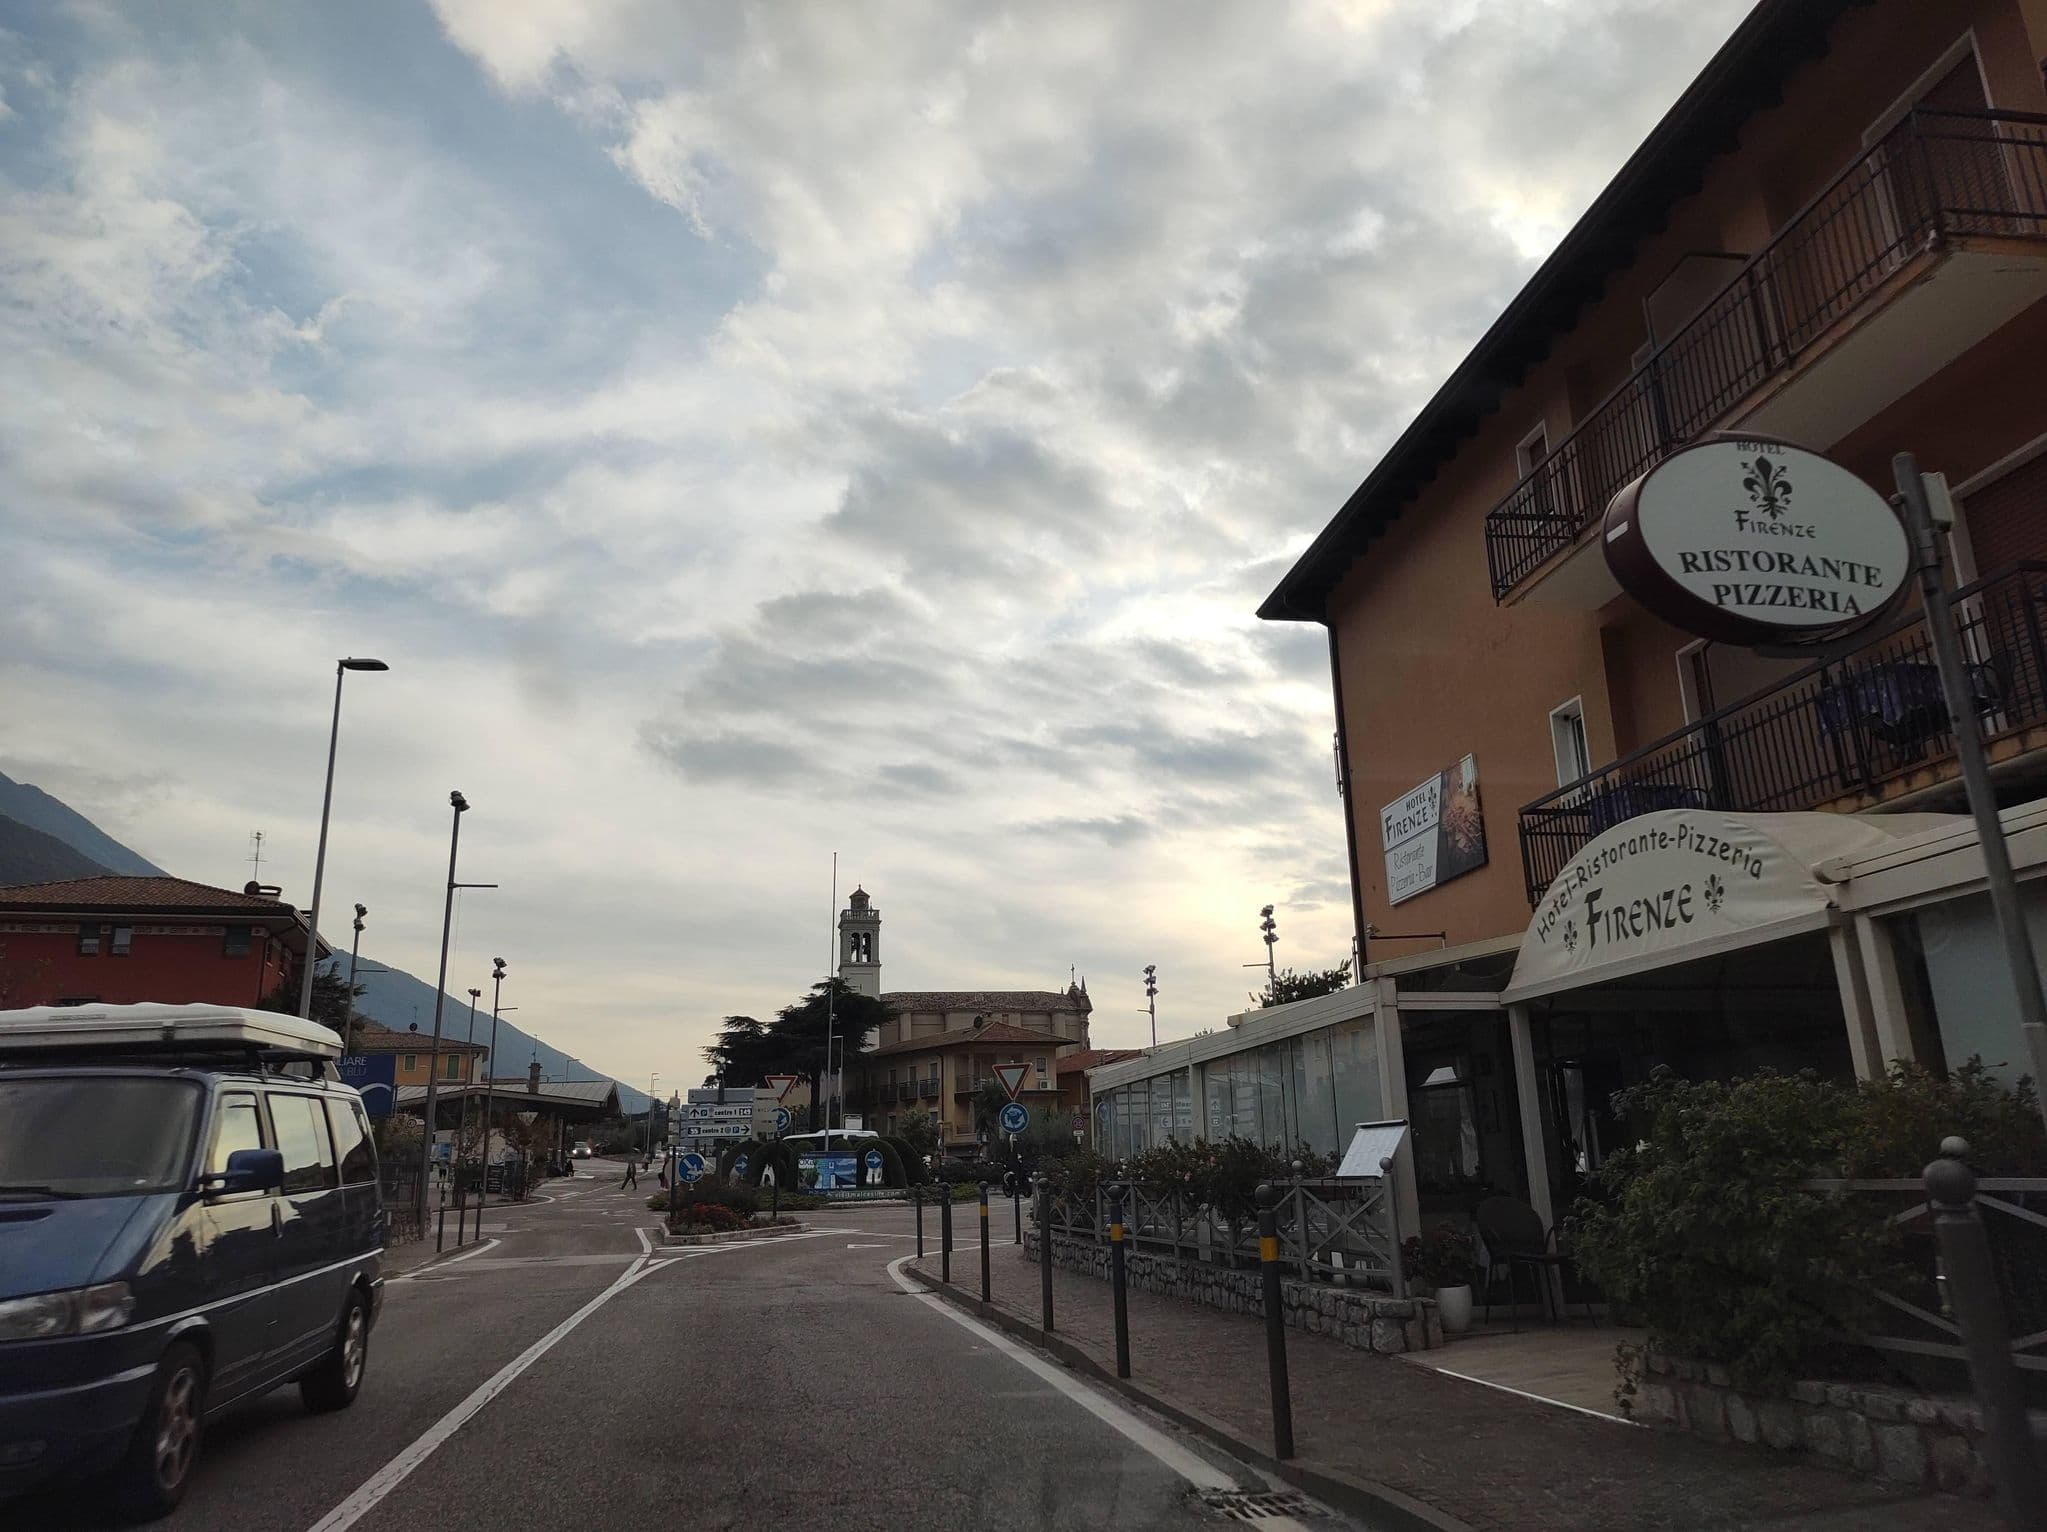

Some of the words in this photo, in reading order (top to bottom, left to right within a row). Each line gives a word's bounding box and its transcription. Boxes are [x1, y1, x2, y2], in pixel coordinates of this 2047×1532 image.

[1677, 550, 1883, 589] RISTORANTE
[1711, 584, 1862, 616] PIZZERIA
[1405, 792, 1426, 812] HOTEL
